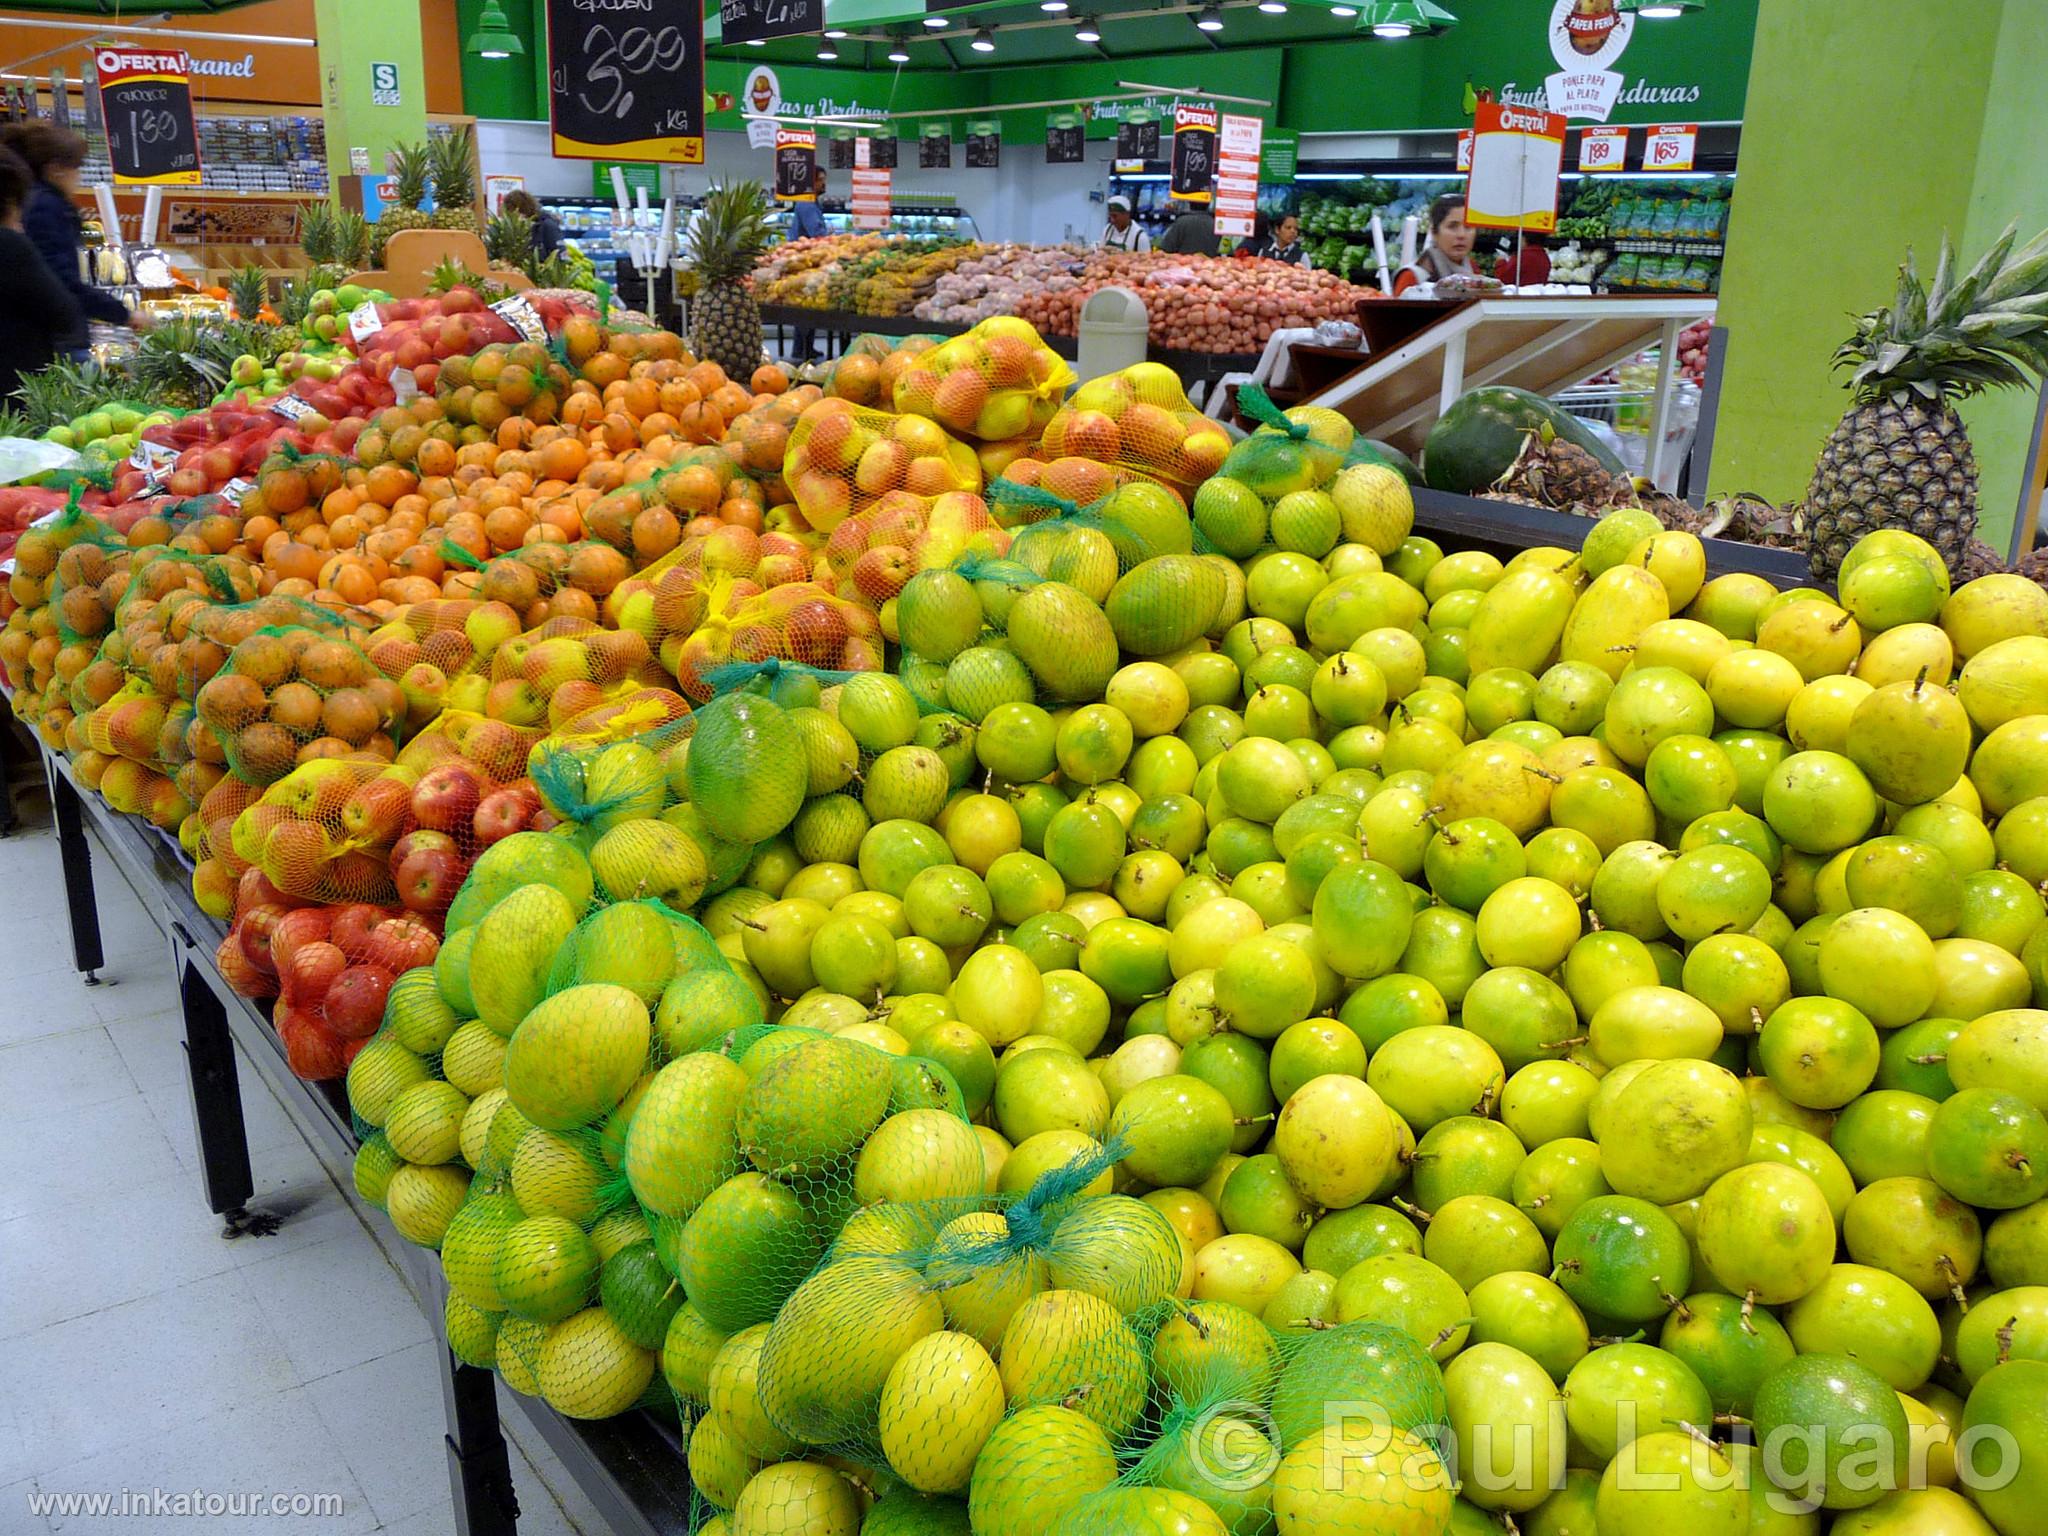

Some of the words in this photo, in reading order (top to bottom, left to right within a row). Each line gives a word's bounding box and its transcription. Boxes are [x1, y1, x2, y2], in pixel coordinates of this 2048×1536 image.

[97, 51, 186, 74] OFERTA!
[184, 51, 255, 78] ranel
[376, 65, 395, 89] S
[1562, 75, 1584, 87] PONLE
[1586, 74, 1605, 87] PAPA
[1567, 90, 1575, 100] AL
[1577, 89, 1600, 100] PLATO
[1176, 109, 1217, 127] OFERTA!
[1500, 110, 1548, 133] OFERTA!
[777, 132, 815, 144] OFERTA!
